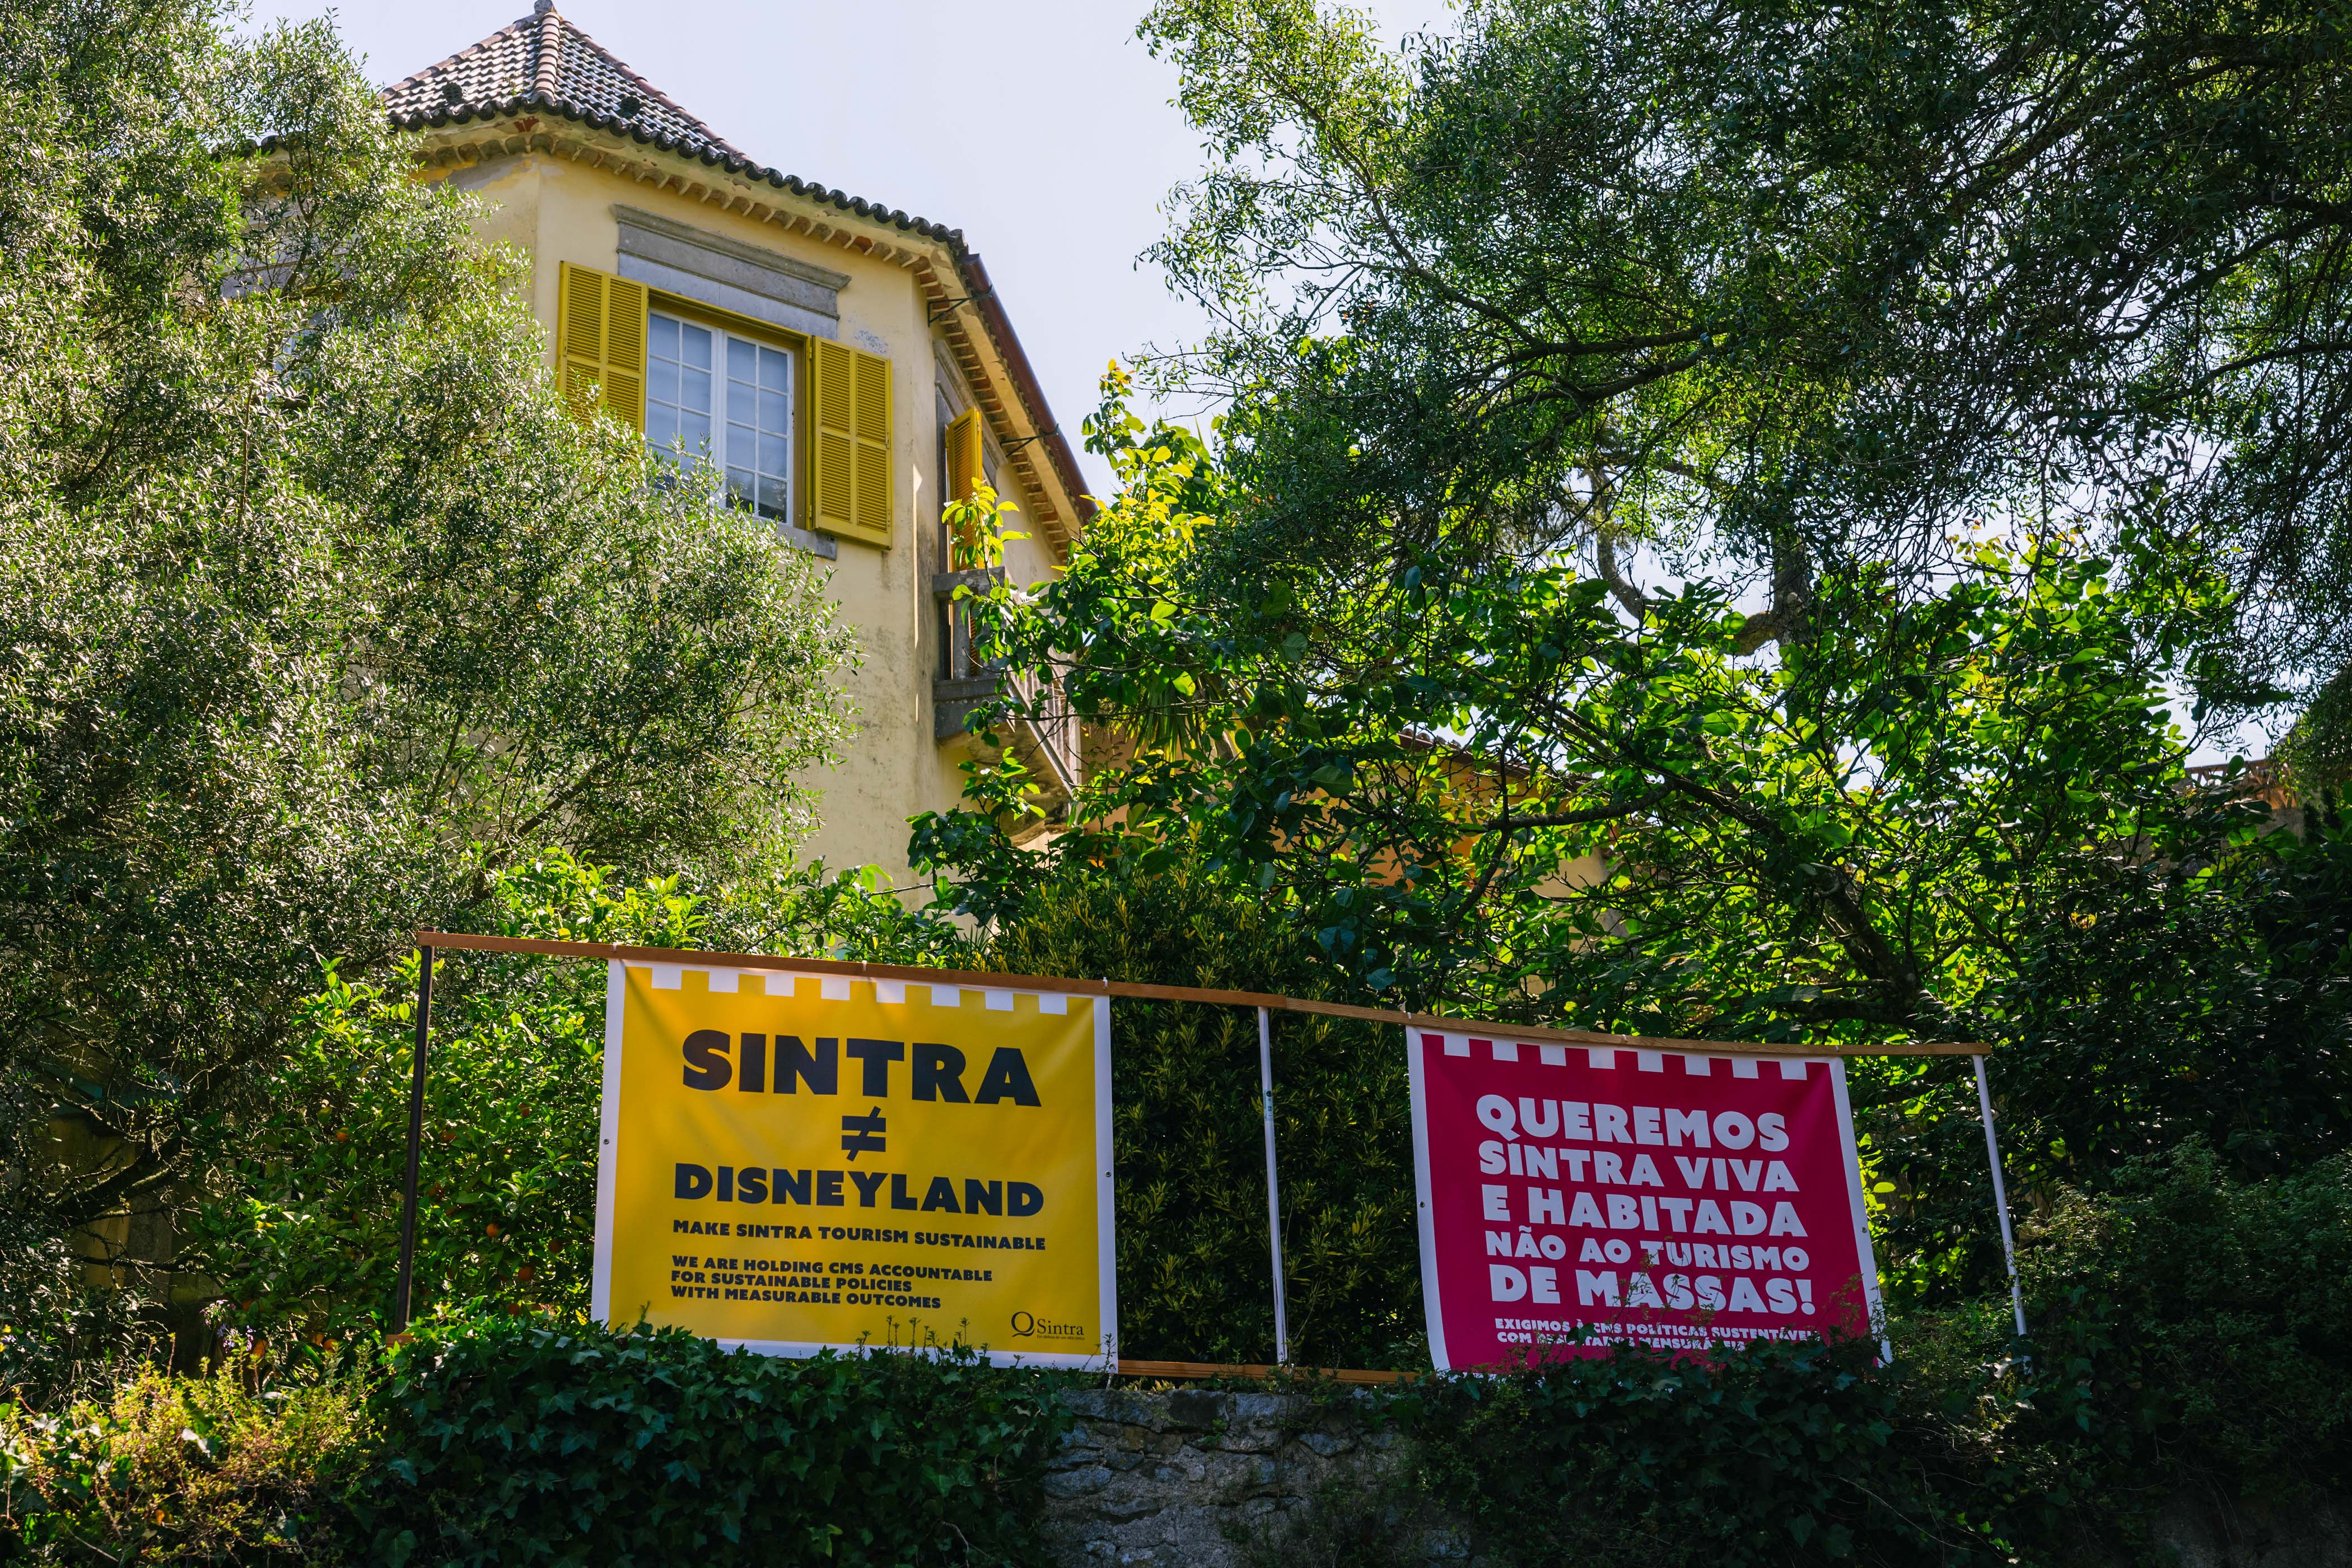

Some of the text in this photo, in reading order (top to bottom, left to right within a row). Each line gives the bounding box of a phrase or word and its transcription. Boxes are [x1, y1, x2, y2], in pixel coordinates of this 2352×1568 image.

[683, 1030, 1042, 1107] SINTRA
[1477, 1095, 1789, 1151] QUEREMOS
[1479, 1141, 1799, 1191] SINTRA VIVA
[675, 1163, 1044, 1216] DISNEYLAND
[1482, 1184, 1808, 1236] E HABITADA
[674, 1220, 1045, 1250] MAKE SINTRA TOURISM SUSTAINABLE
[1486, 1226, 1809, 1271] NÃO AO TURISMO
[671, 1271, 912, 1292] FOR SUSTAINABLE POLICIES
[672, 1256, 992, 1281] WE ARE HOLDING CMS ACCOUNTABLE
[1490, 1264, 1815, 1314] DE MASSAS!
[671, 1286, 941, 1308] WITH MEASURABLE OUTCOMES
[1495, 1318, 1571, 1332] EXIGIMOS
[1594, 1323, 1622, 1333] CMS
[1626, 1322, 1709, 1338] POLÍTICAS
[1497, 1332, 1532, 1343] COM
